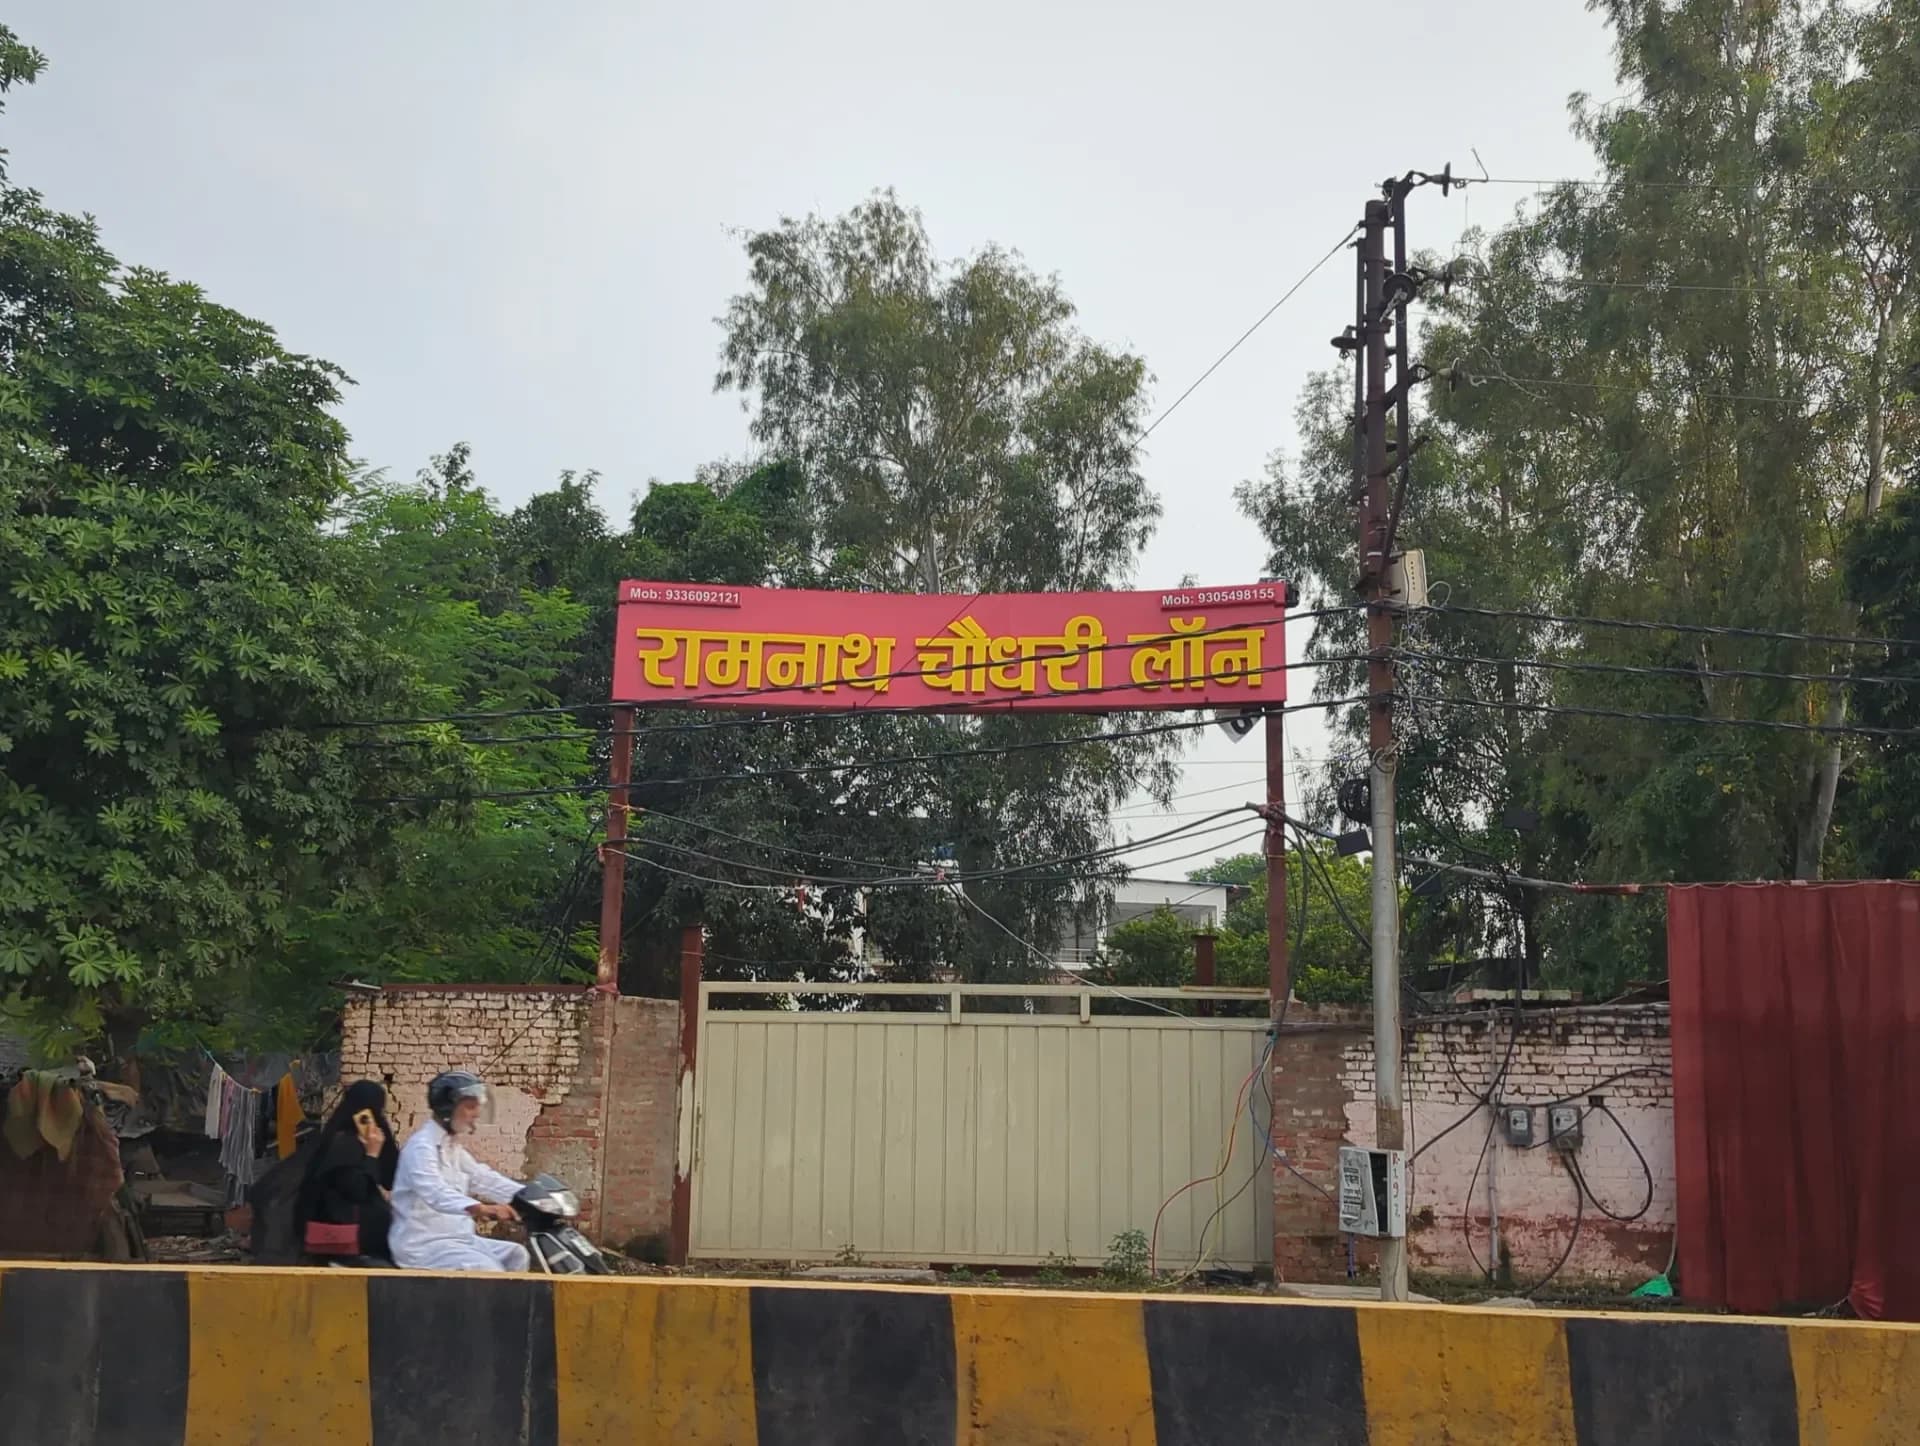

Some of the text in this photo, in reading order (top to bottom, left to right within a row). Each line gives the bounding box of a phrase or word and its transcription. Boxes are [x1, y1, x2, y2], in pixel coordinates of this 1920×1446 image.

[630, 587, 740, 604] Mob: 9336092121
[1162, 588, 1275, 606] Mob: 9305498155
[637, 615, 1265, 693] रामनाथ चौधरी लॉन
